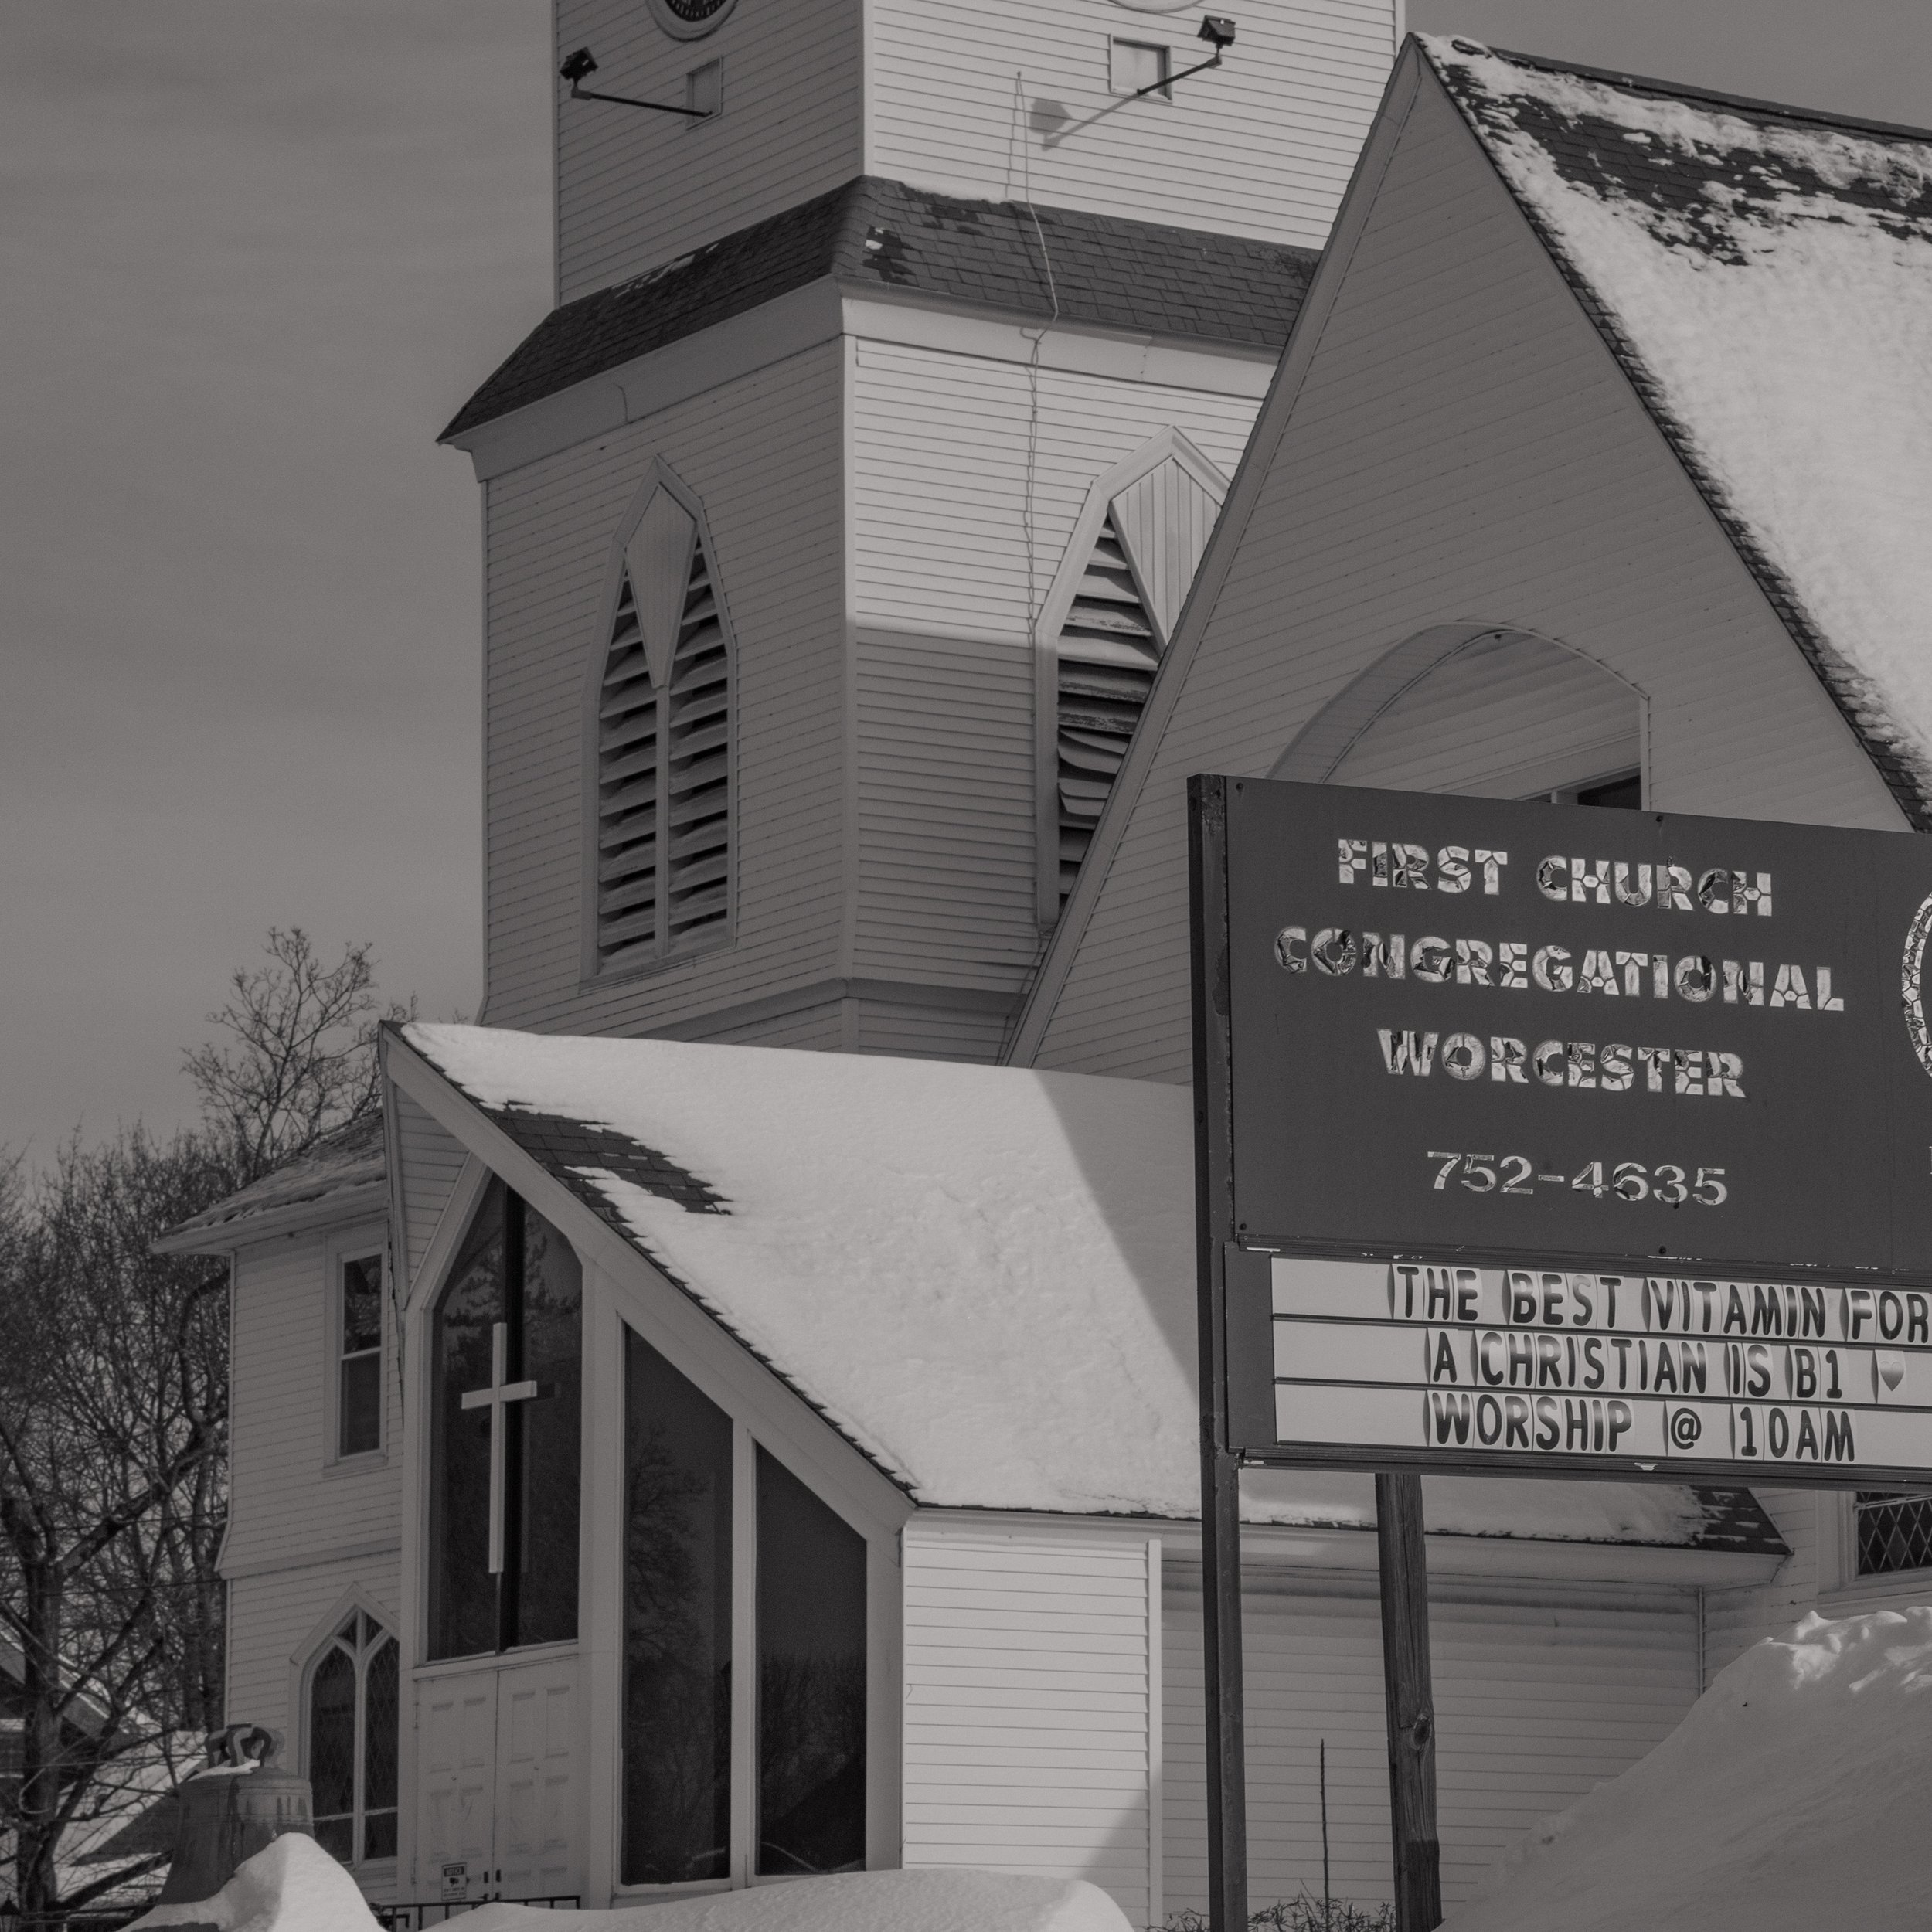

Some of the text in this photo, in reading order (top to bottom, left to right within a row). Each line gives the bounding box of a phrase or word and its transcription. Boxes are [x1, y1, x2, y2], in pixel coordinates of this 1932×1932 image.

[1338, 838, 1773, 917] FIRST CHURCH
[1274, 926, 1845, 1012] CONGREGATIONAL
[1376, 1028, 1747, 1099] WORCESTER
[1427, 1151, 1729, 1206] 752-4635
[1396, 1266, 1929, 1344] THE BEST VITAMIN FOR
[1433, 1331, 1842, 1399] A CHRISTIAN IS B1
[1431, 1392, 1855, 1462] WORSHIP @ 10AM
